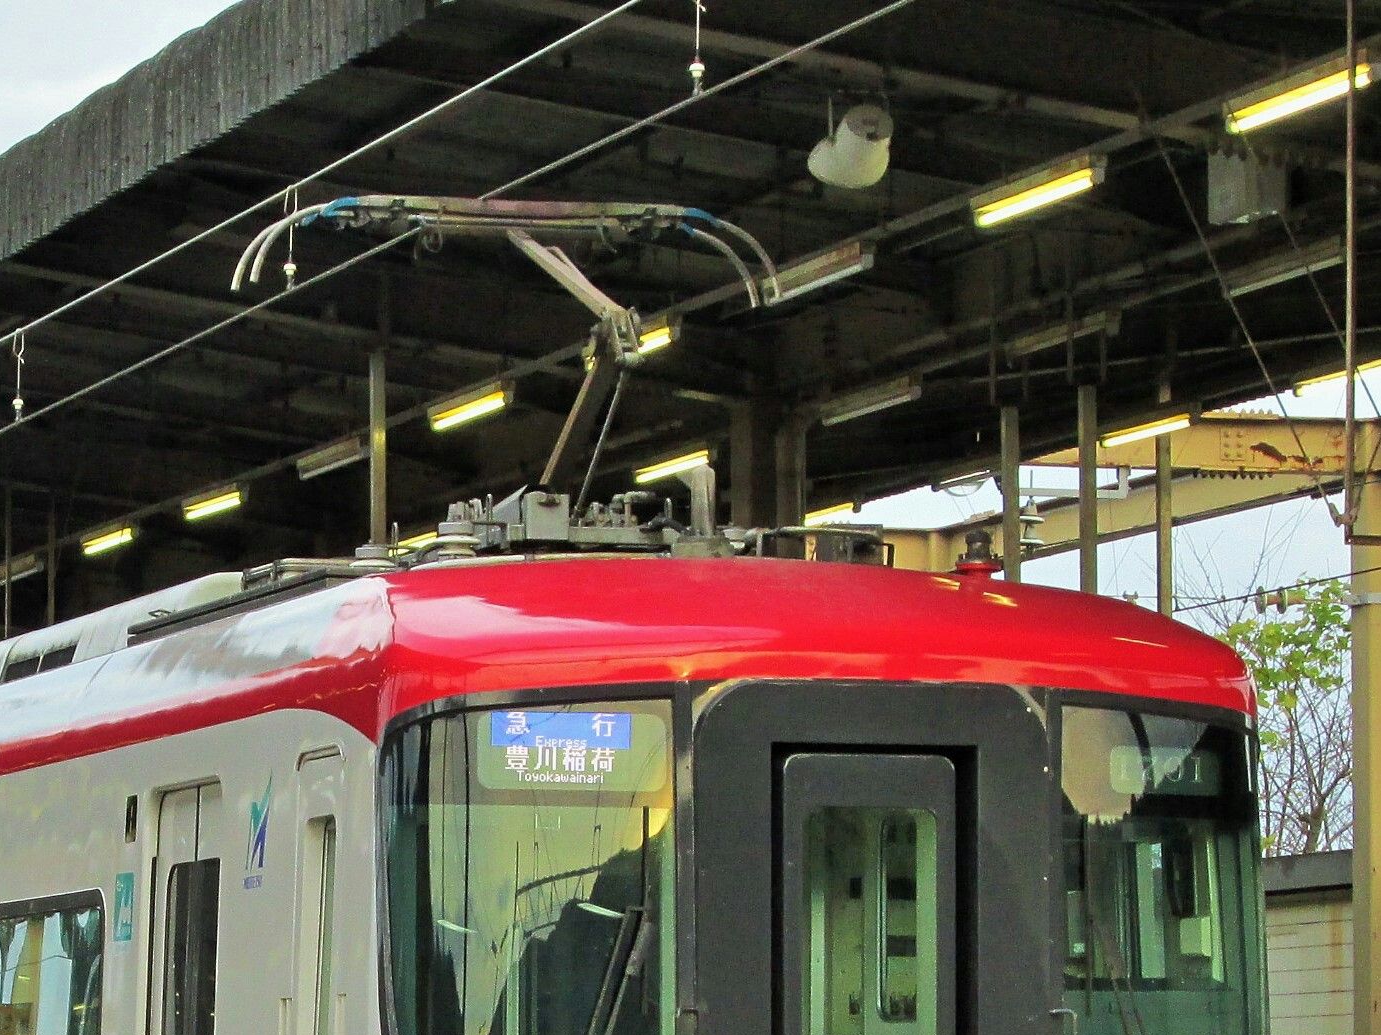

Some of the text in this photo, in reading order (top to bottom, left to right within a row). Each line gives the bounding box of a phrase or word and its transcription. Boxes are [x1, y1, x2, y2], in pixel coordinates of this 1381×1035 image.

[535, 735, 587, 750] Express
[505, 745, 616, 773] 豊川稲荷
[516, 770, 605, 784] Toyokawainari
